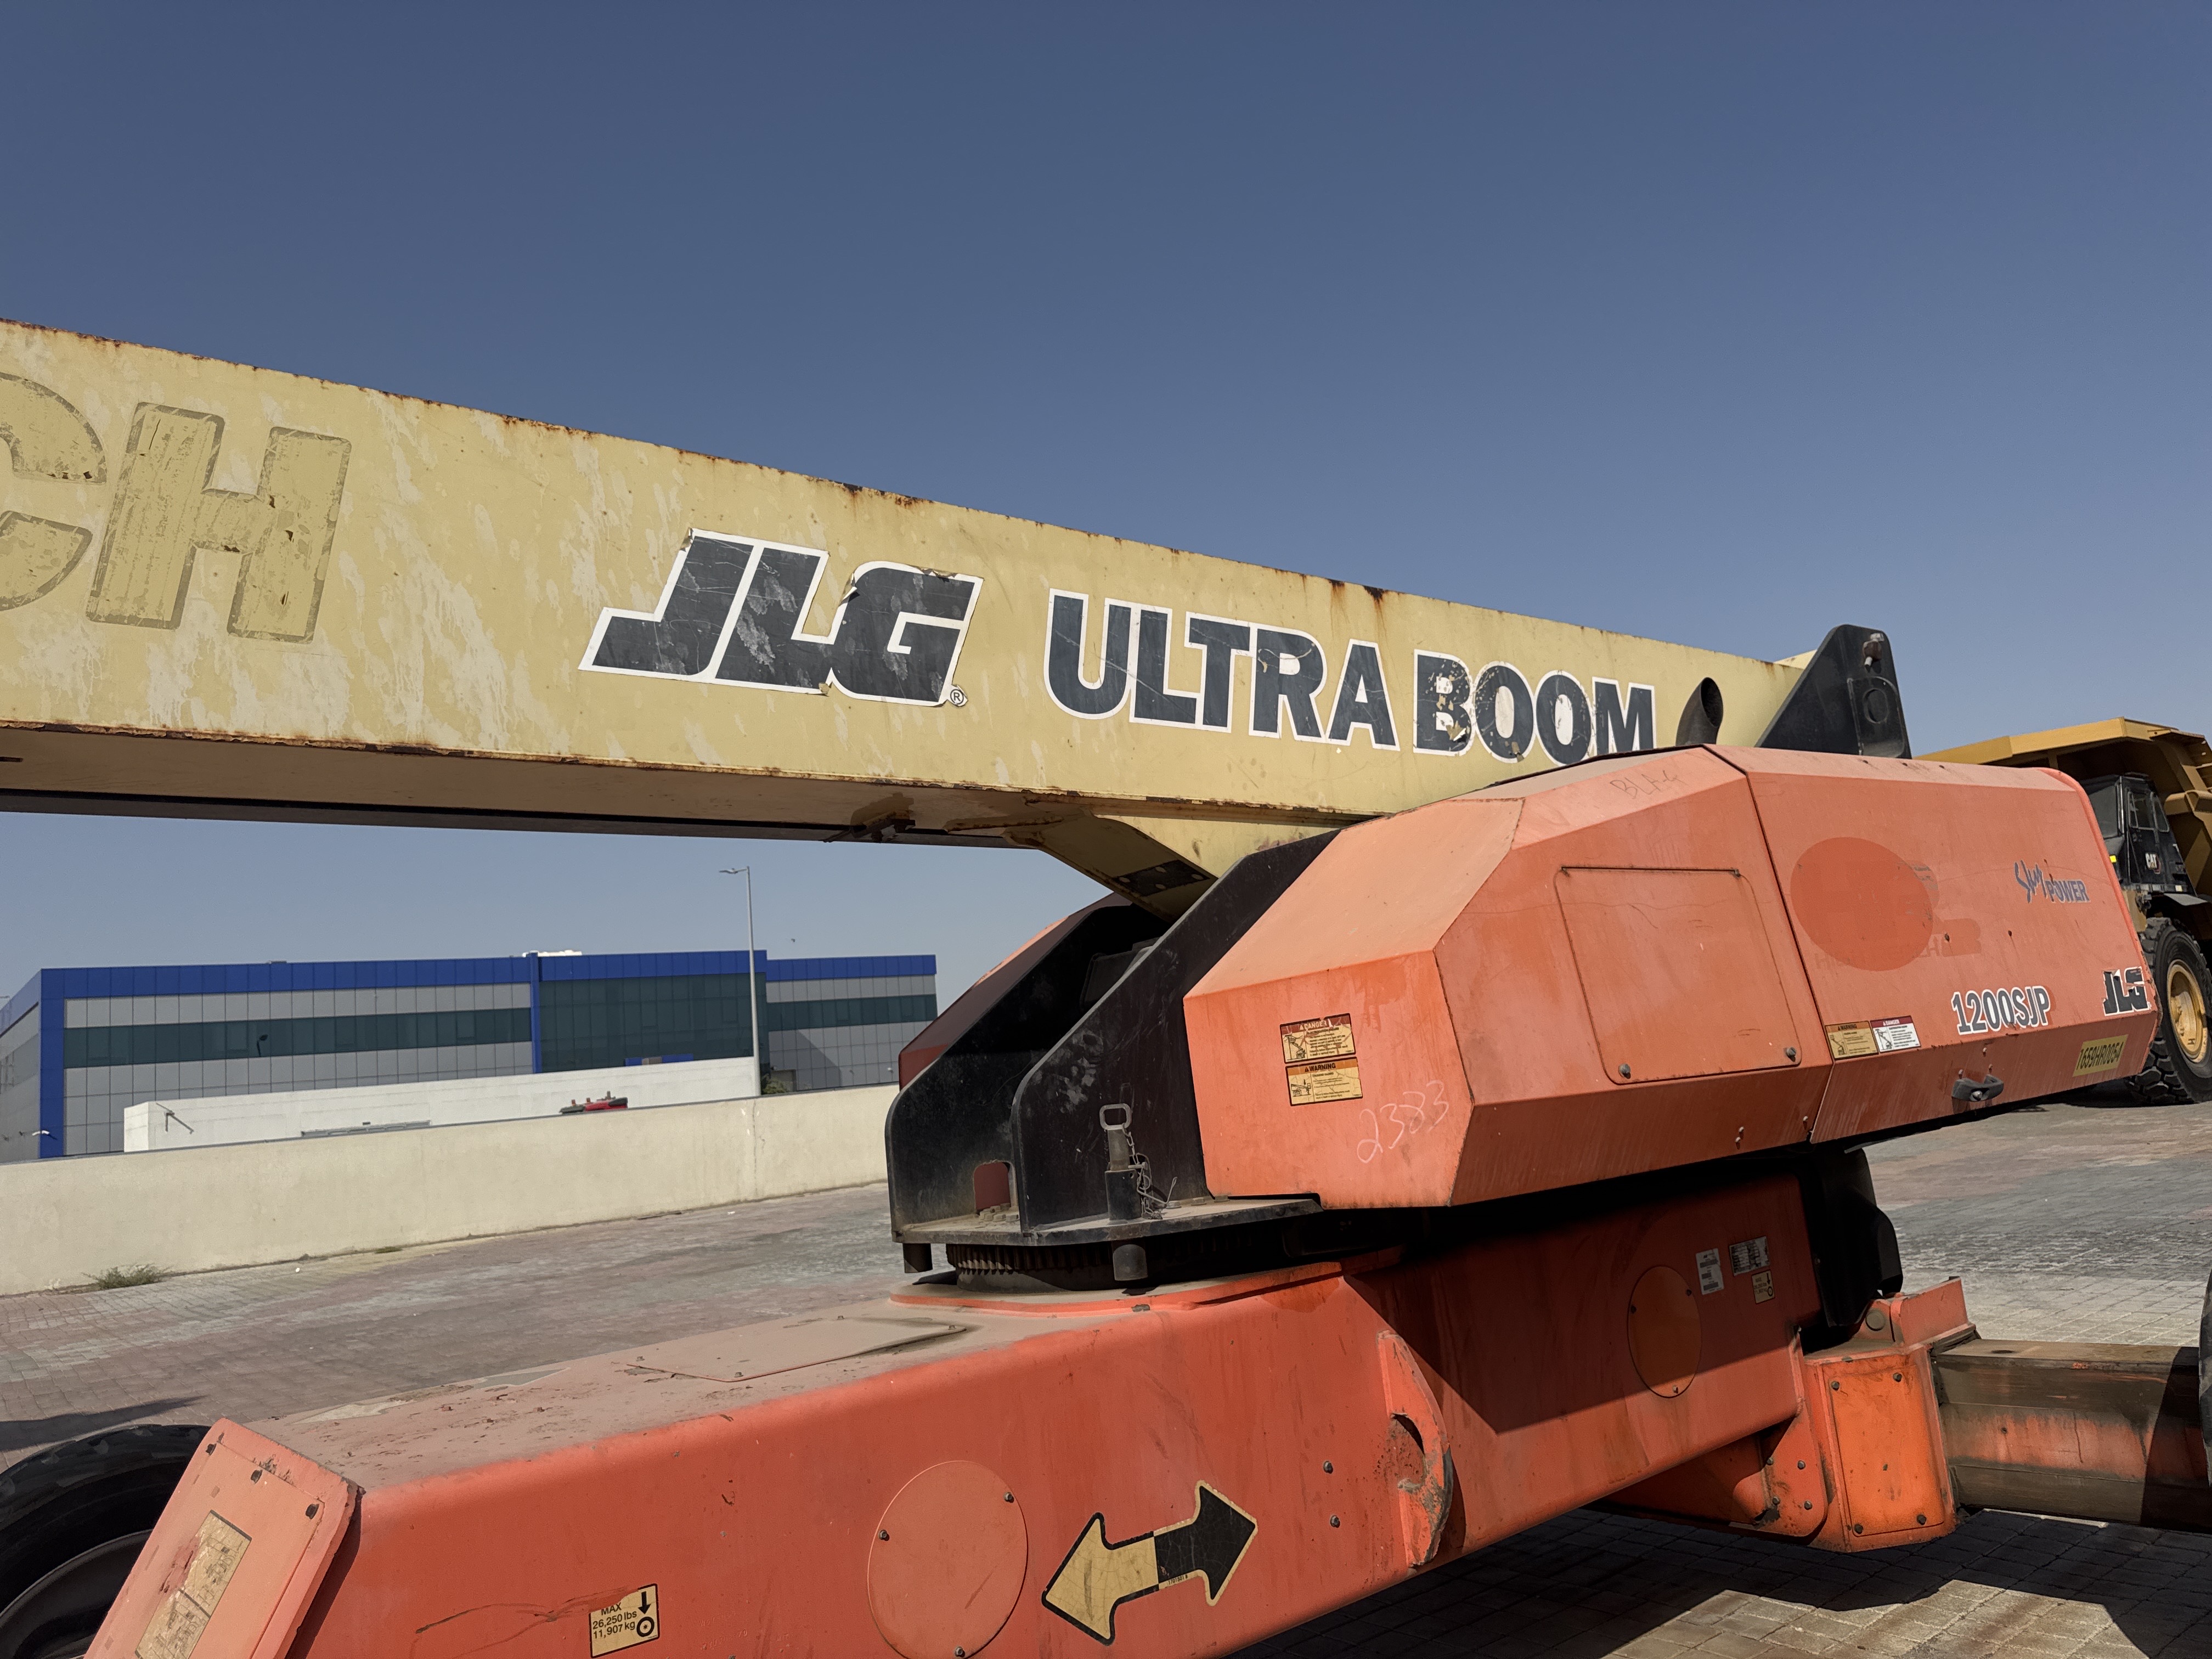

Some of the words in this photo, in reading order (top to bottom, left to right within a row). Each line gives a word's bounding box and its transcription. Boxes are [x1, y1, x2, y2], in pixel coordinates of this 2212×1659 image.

[578, 528, 984, 707] JLG
[1043, 588, 1401, 751] ULTRA
[1412, 648, 1657, 765] BOOM
[2145, 852, 2158, 869] CAT
[2103, 966, 2152, 1017] JLG
[1951, 985, 2051, 1035] 1200SJP
[1310, 1063, 1336, 1072] WARNING
[601, 1602, 622, 1616] MAX
[592, 1613, 623, 1630] 26,250
[624, 1611, 637, 1621] lbs
[593, 1624, 623, 1639] 11,907
[624, 1621, 636, 1631] kg
